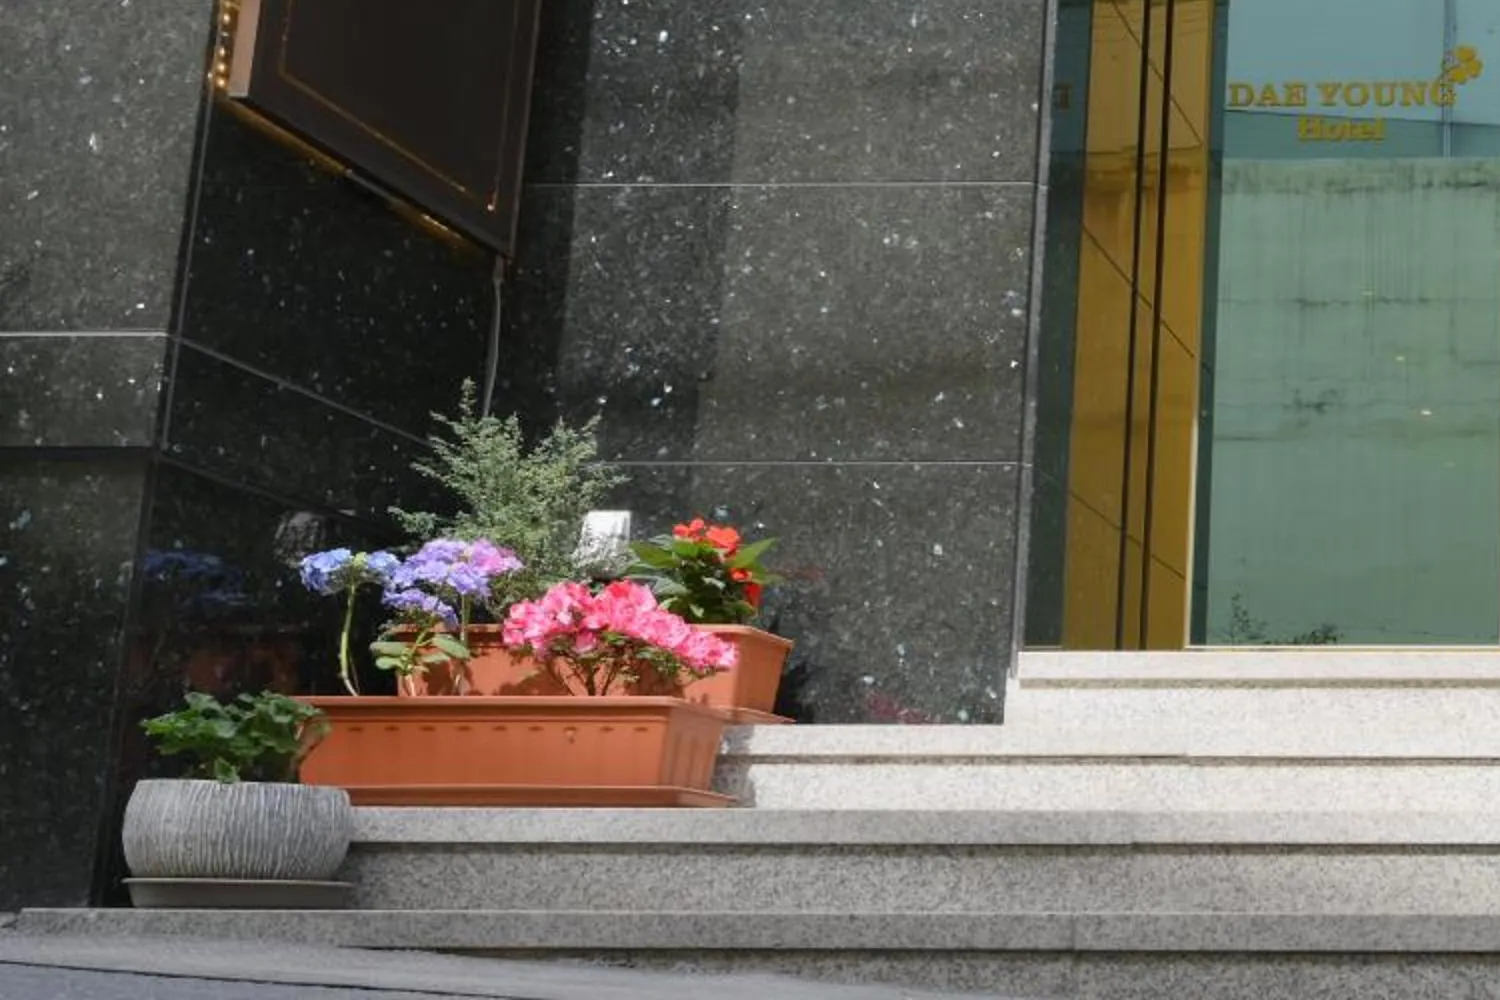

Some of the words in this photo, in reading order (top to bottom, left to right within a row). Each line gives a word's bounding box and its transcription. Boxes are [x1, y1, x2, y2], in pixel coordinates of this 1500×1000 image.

[1228, 81, 1307, 107] DAE
[1315, 79, 1457, 107] YOUNG
[1297, 114, 1386, 142] Hotel
